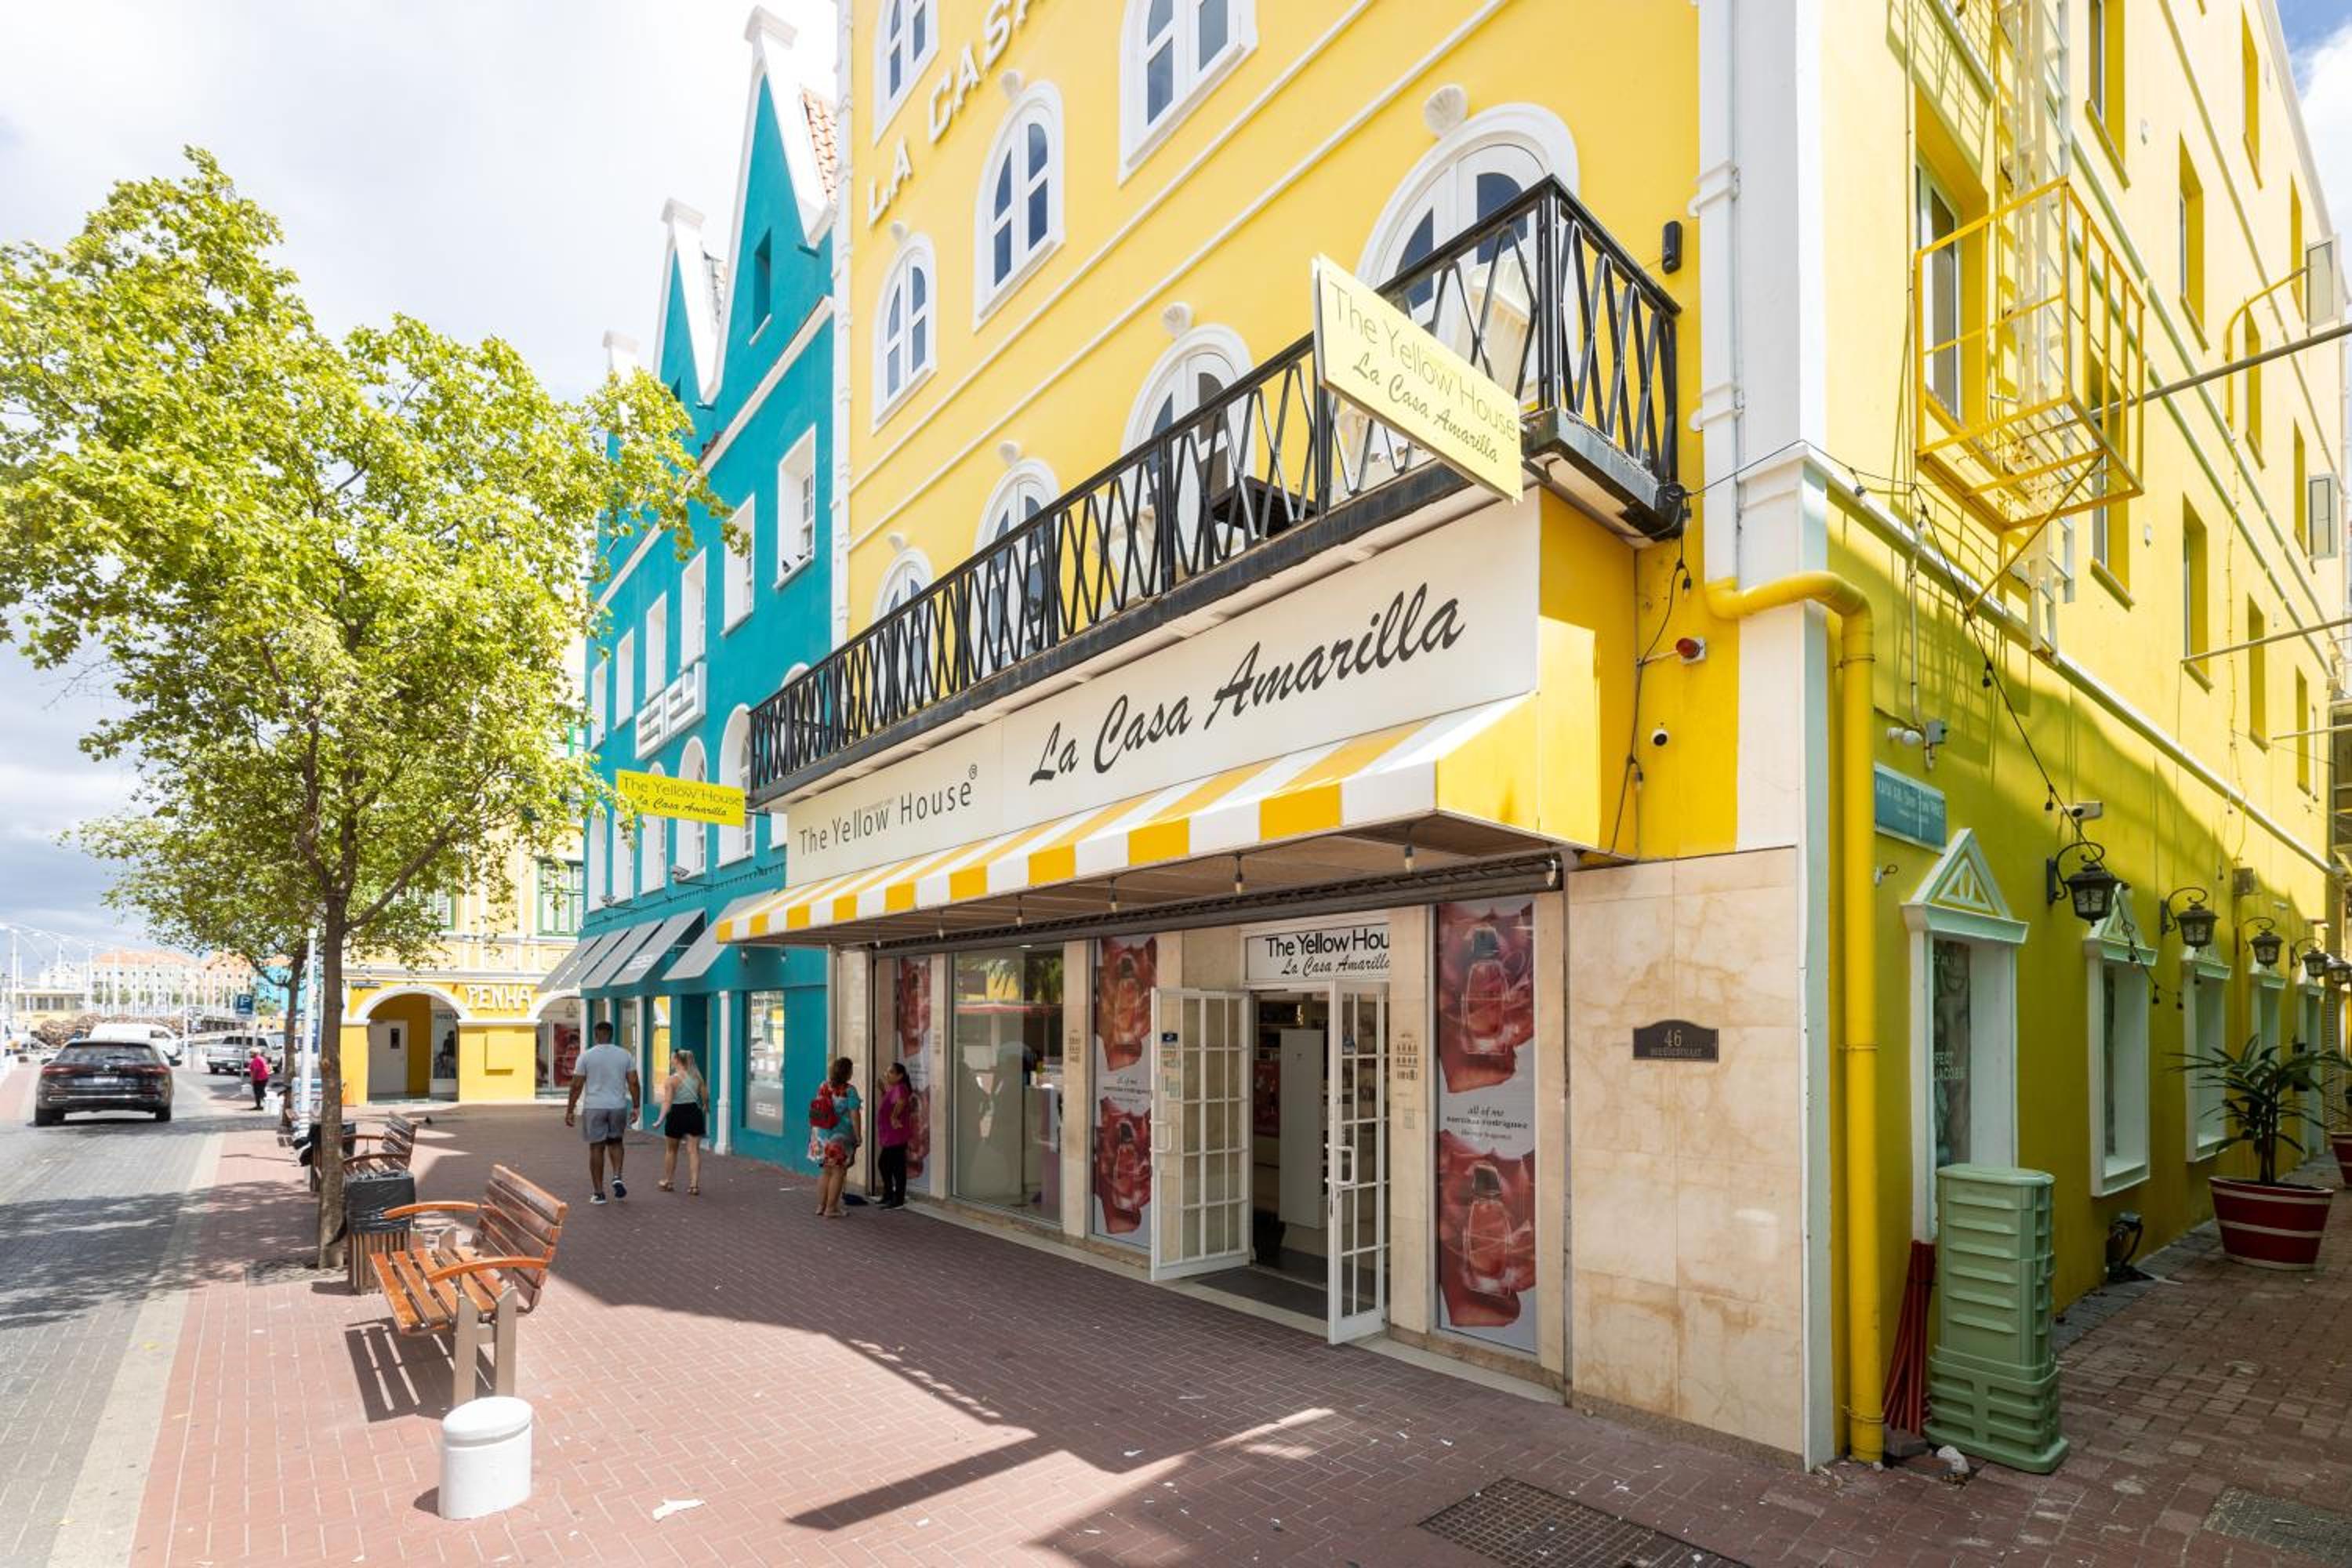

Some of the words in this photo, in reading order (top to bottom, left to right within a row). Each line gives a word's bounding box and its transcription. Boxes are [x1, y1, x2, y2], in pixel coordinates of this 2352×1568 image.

[869, 136, 913, 227] LA
[1330, 280, 1377, 344] The
[1384, 319, 1452, 397] Yellow
[1458, 376, 1517, 443] House
[1352, 351, 1381, 386] La
[1388, 373, 1430, 419] Casa
[1432, 408, 1499, 463] Amarilla
[1029, 720, 1079, 786] La
[1093, 694, 1193, 775] Casa
[1204, 583, 1466, 731] Amarilla
[624, 776, 648, 793] The
[652, 781, 698, 800] Yellow
[701, 791, 742, 807] House
[652, 795, 679, 811] Casa
[681, 801, 728, 817] Amarilla
[799, 827, 828, 855] The
[832, 807, 890, 845] Yellow
[1265, 936, 1295, 958] The
[1296, 931, 1350, 956] Yellow
[1281, 958, 1298, 975] La
[1302, 956, 1332, 978] Casa
[240, 996, 250, 1007] P
[465, 985, 533, 1010] PENHA
[1664, 1029, 1682, 1046] 46
[1468, 1105, 1479, 1115] all
[1481, 1106, 1490, 1117] of
